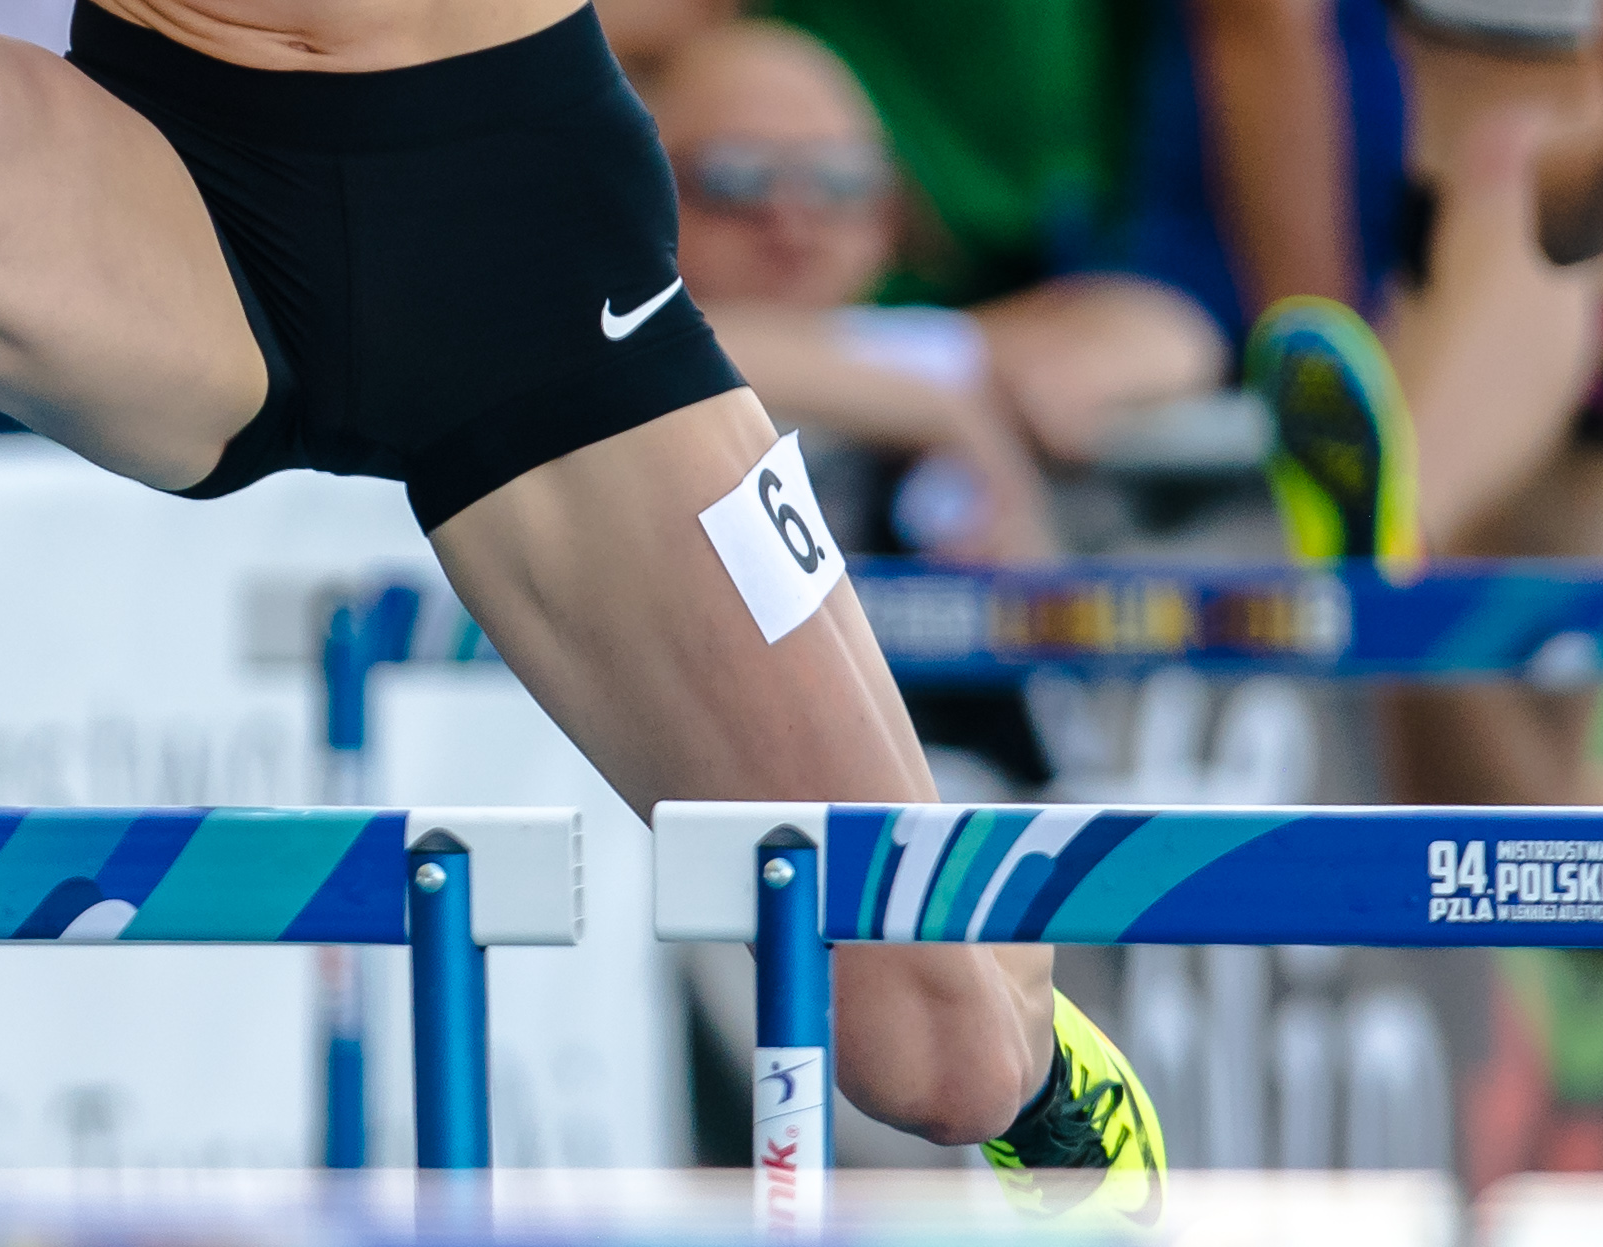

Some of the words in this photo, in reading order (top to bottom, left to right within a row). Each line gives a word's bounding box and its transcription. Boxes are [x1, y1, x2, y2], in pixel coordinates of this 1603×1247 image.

[758, 468, 826, 575] 6.
[1427, 839, 1495, 896] 94.
[1428, 897, 1495, 923] PZLA
